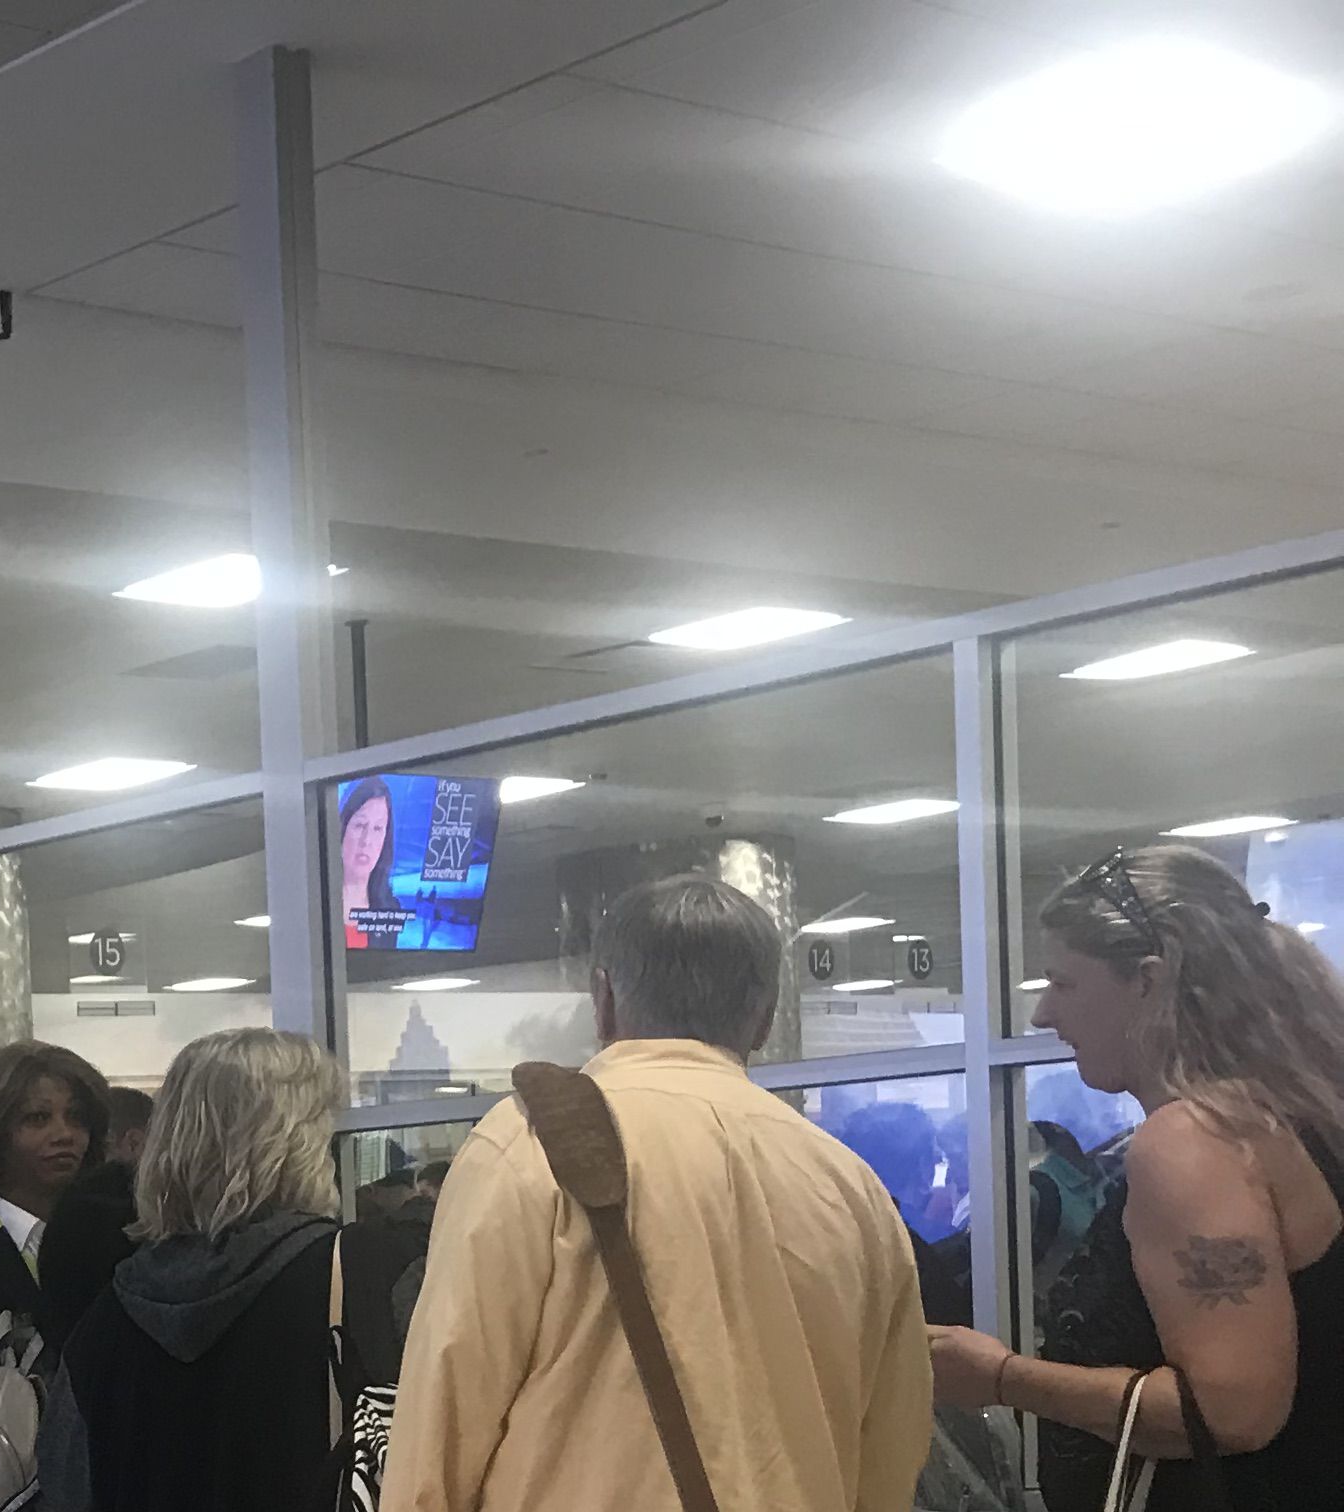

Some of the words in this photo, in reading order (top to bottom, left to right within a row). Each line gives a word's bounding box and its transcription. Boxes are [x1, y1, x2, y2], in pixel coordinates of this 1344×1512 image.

[432, 792, 476, 826] SEE
[431, 825, 471, 838] something
[425, 836, 471, 868] SAY
[94, 937, 120, 966] 15
[812, 948, 832, 973] 14
[912, 948, 930, 973] 13
